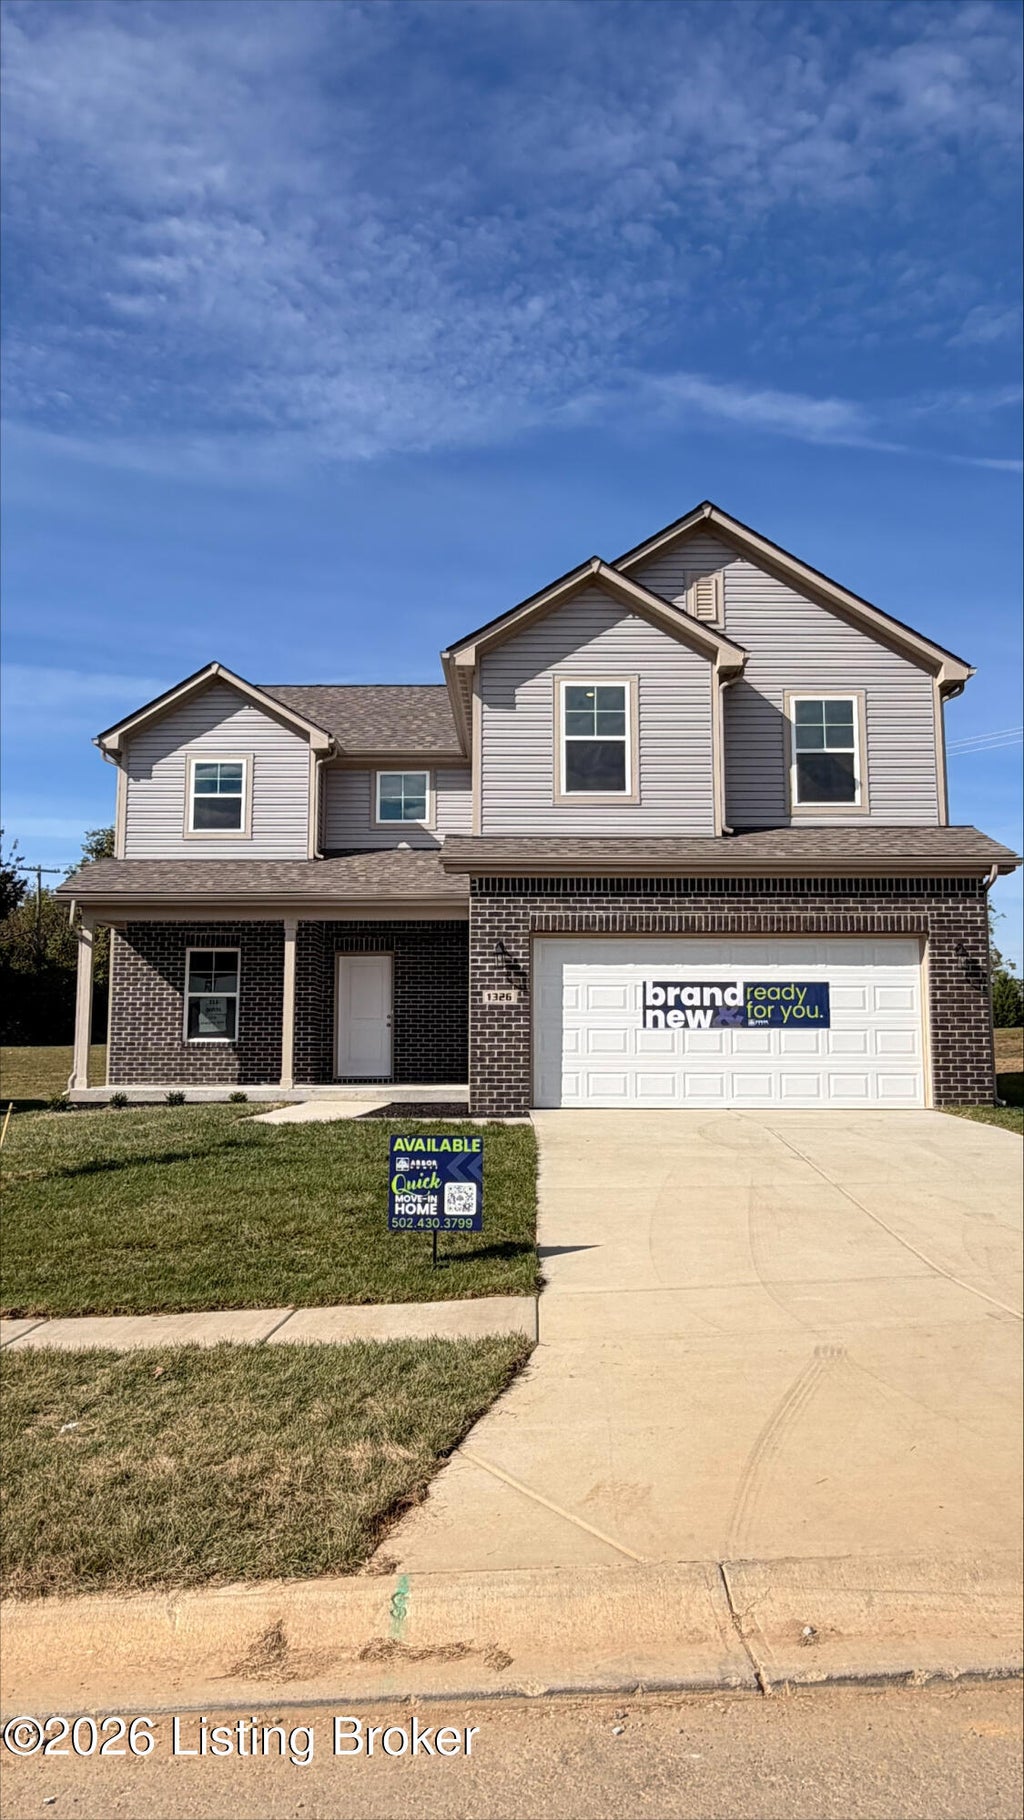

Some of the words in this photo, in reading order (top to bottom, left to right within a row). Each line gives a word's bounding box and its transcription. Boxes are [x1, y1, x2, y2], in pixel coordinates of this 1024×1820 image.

[487, 993, 512, 1001] 1326
[645, 981, 744, 1007] brand
[746, 984, 807, 1005] ready
[645, 1008, 713, 1028] new
[746, 1001, 775, 1019] for
[780, 1005, 824, 1024] you.
[393, 1138, 481, 1152] AVAILABLE
[391, 1172, 442, 1196] Quick
[394, 1194, 438, 1203] MOVE-IN
[394, 1203, 438, 1215] HOME
[391, 1218, 473, 1229] 502.430.3799
